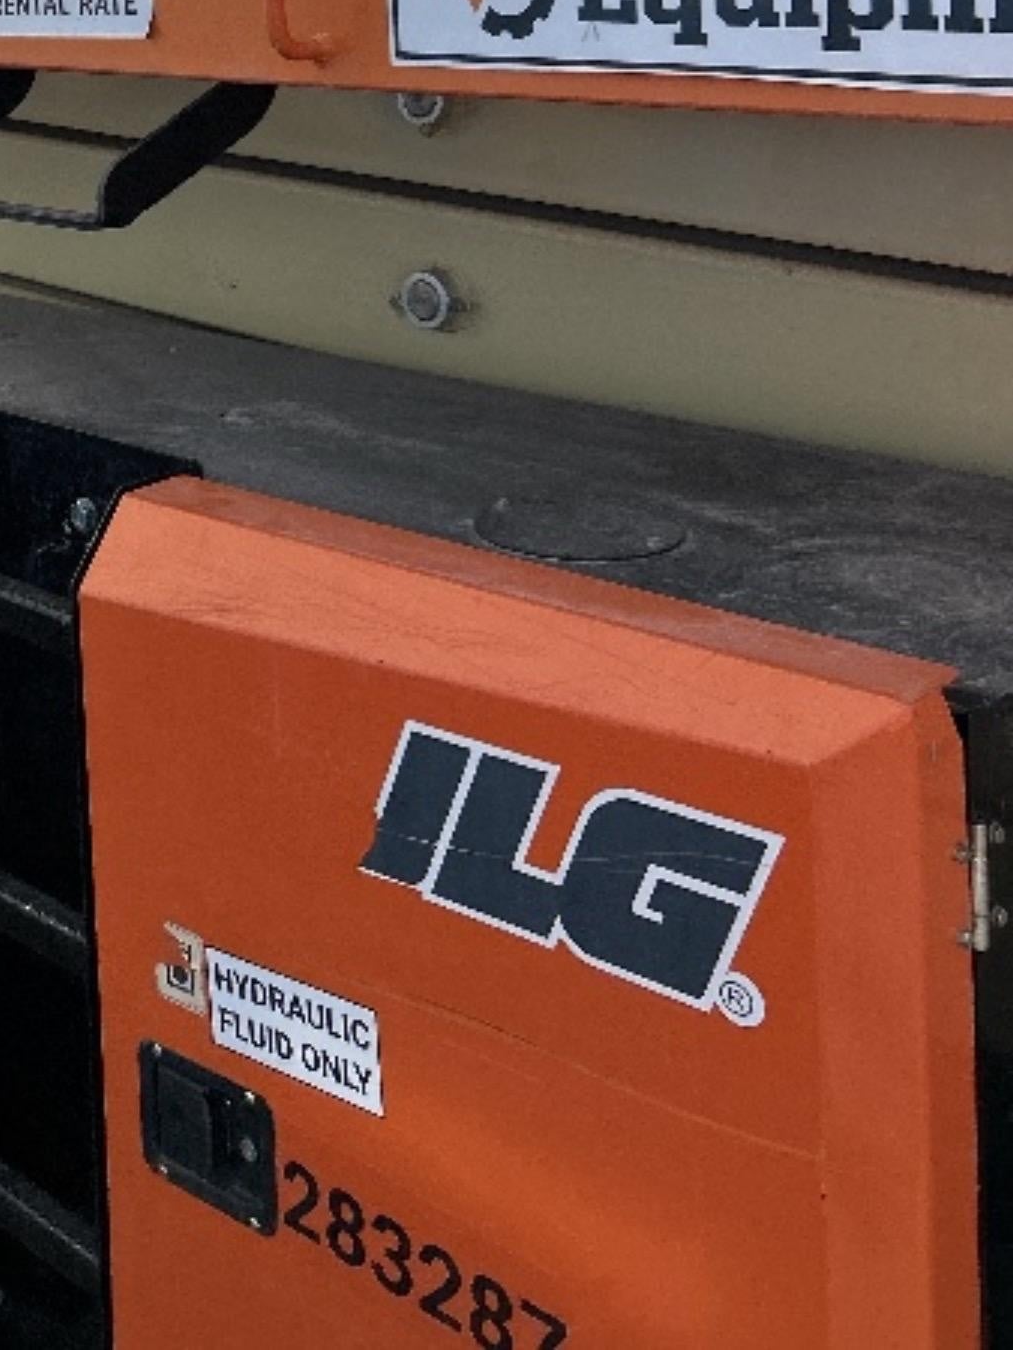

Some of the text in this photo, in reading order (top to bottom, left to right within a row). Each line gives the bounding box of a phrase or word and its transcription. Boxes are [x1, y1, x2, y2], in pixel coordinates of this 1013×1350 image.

[214, 962, 370, 1051] HYDRAULIC
[218, 1005, 372, 1096] FLUID ONLY
[283, 1160, 568, 1350] 283287
